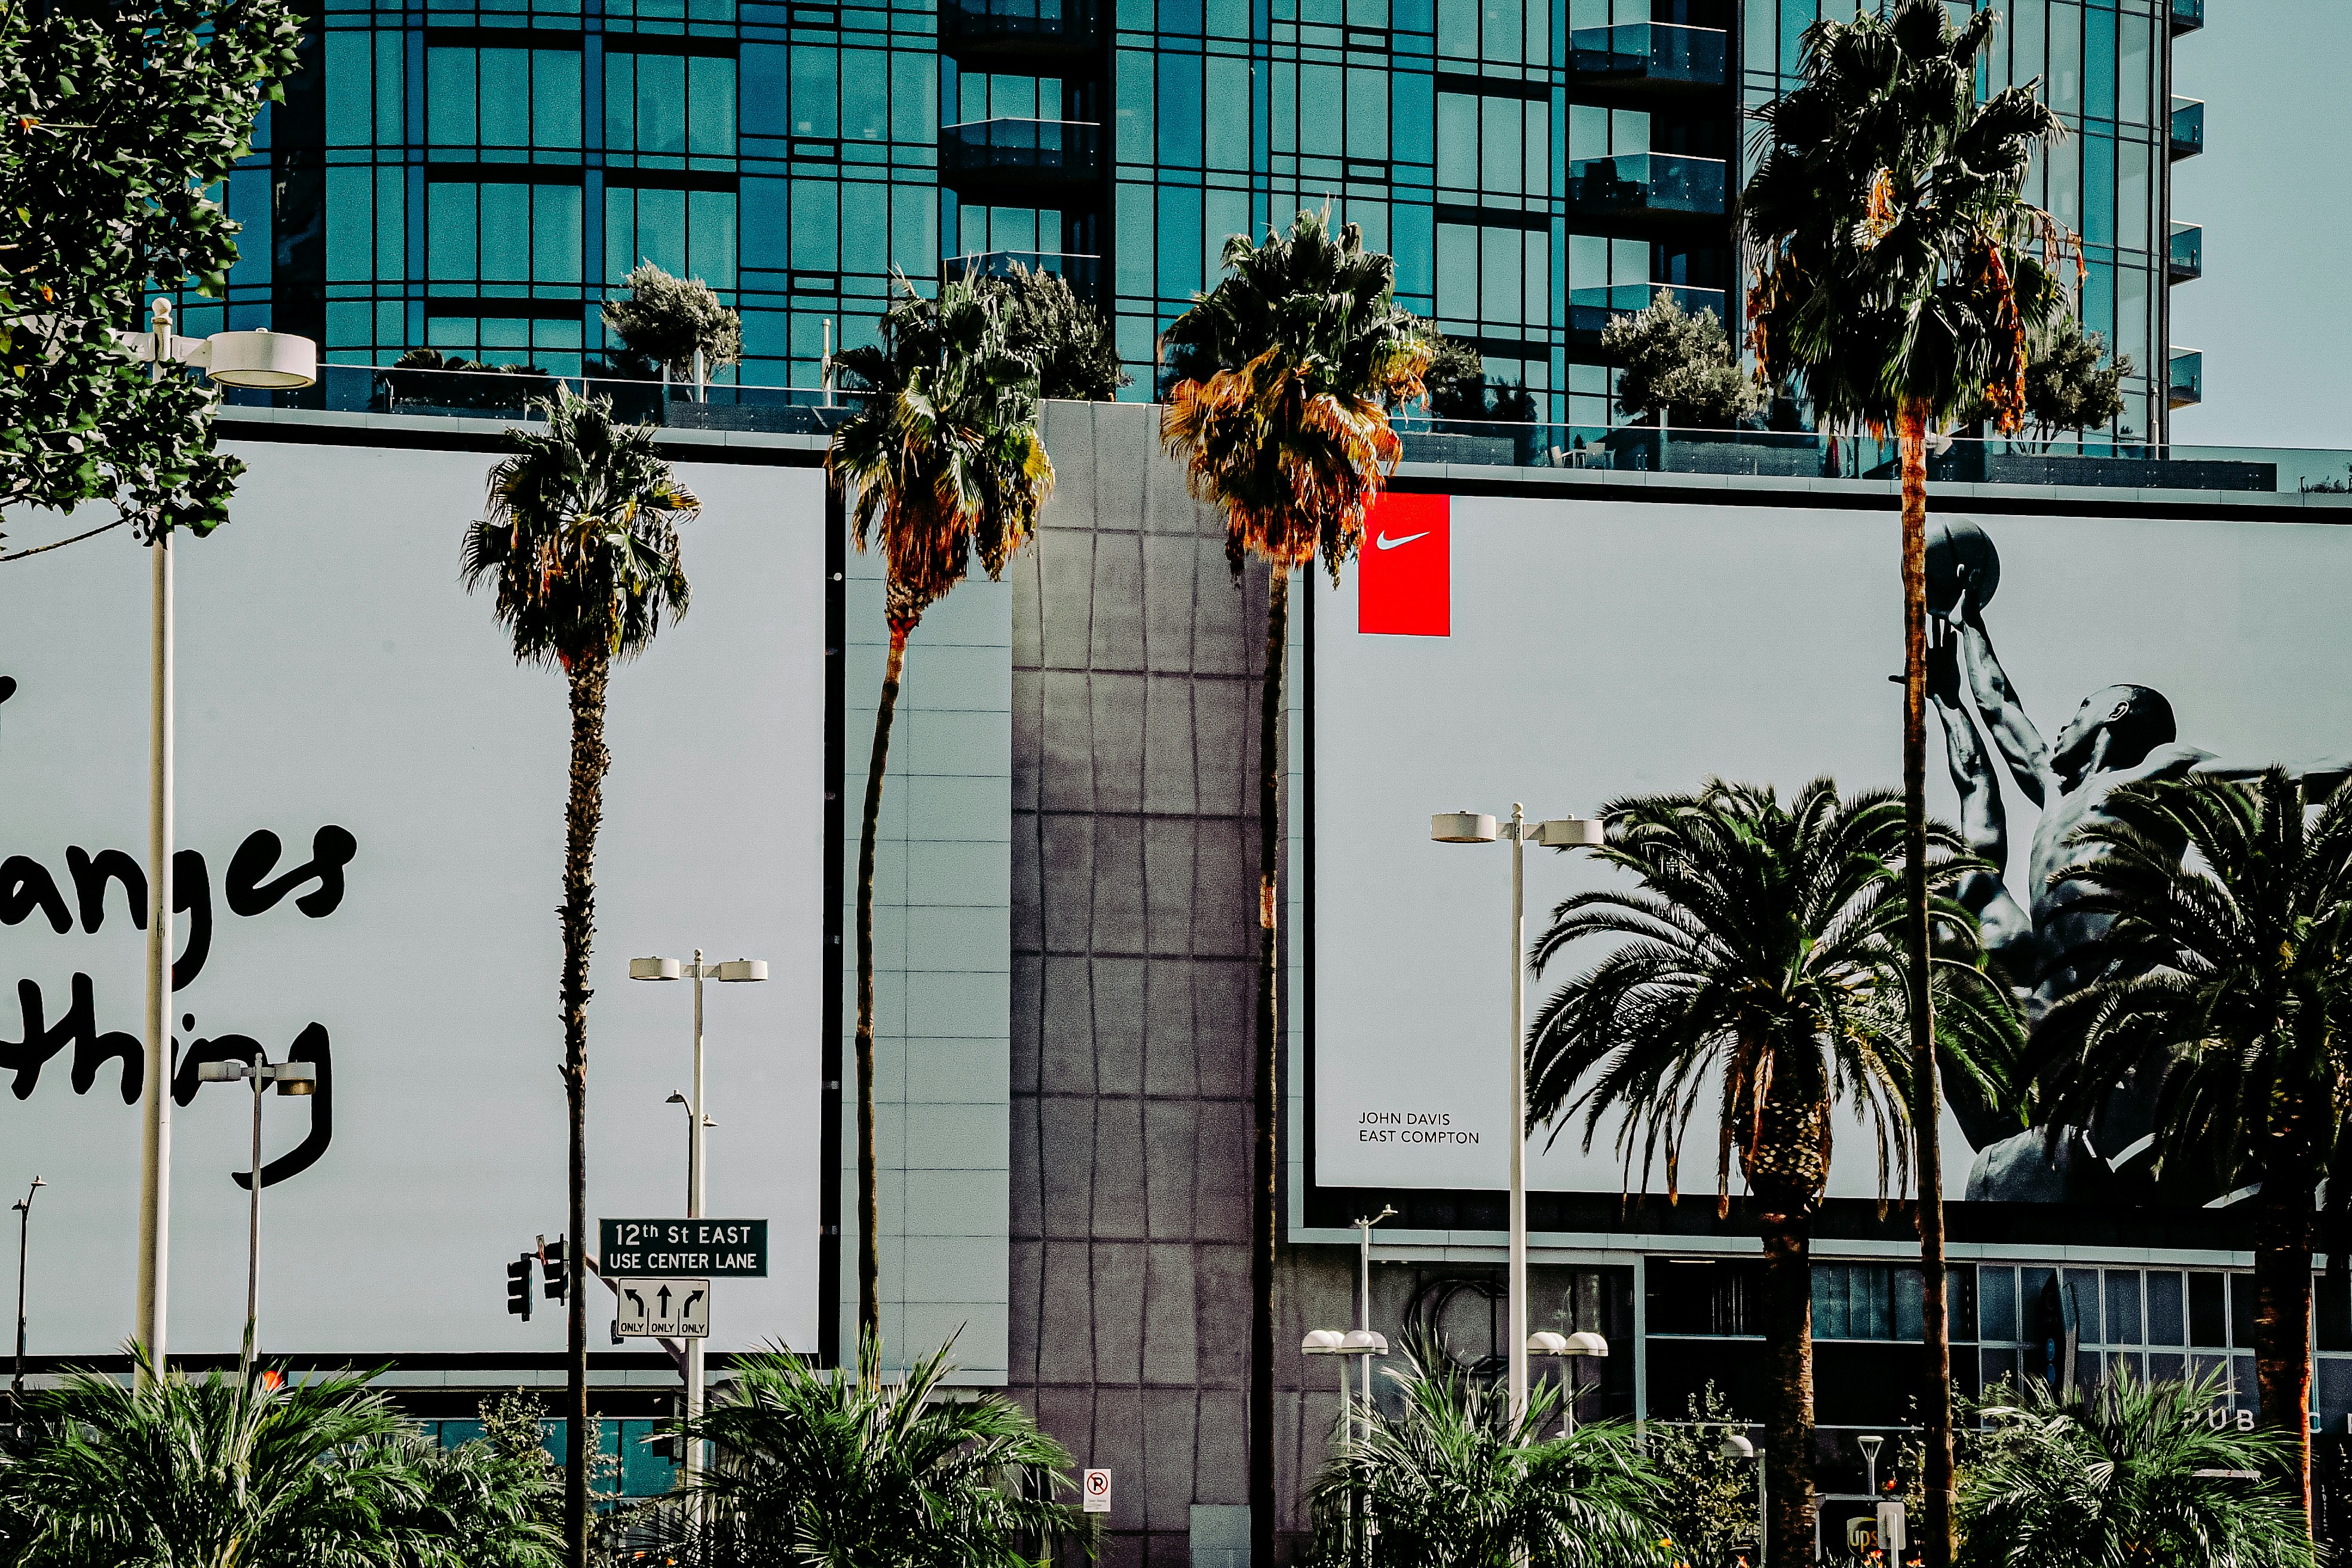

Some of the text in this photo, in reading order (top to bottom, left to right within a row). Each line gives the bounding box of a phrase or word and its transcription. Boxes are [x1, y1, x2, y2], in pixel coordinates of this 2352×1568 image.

[1359, 1112, 1450, 1125] JOHN DAVIS
[1359, 1130, 1479, 1144] EAST COMPTON
[616, 1224, 751, 1245] 12th St EAST
[610, 1254, 757, 1269] USE CENTER LANE
[621, 1323, 644, 1332] ONLY
[651, 1323, 674, 1333] ONLY
[682, 1324, 705, 1333] ONLY
